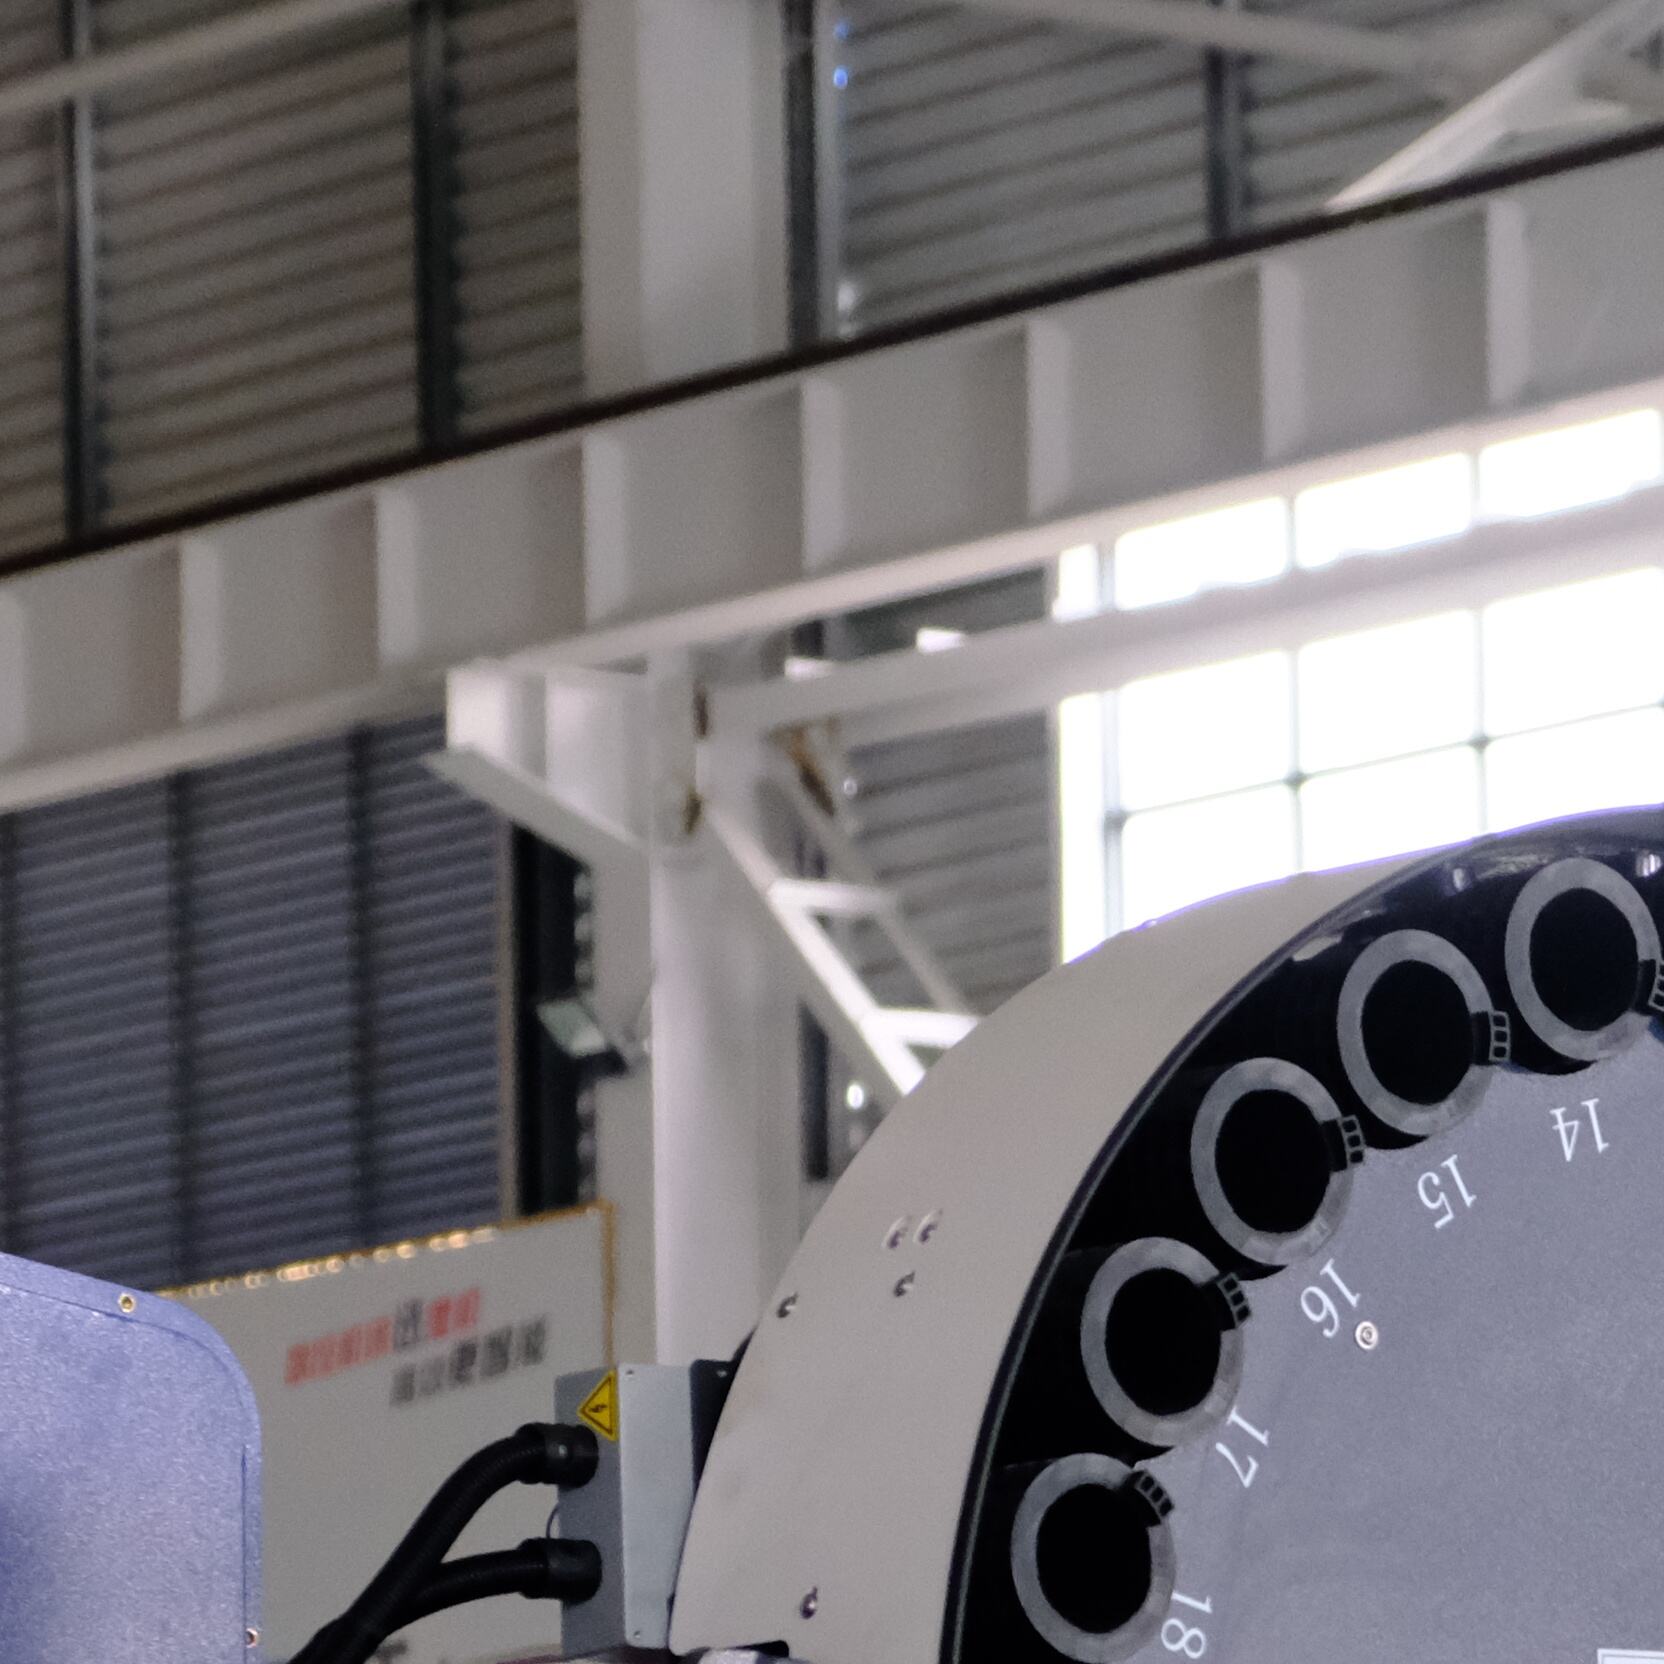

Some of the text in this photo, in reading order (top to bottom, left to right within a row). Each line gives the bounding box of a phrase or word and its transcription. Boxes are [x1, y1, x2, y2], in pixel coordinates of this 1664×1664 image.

[1550, 1098, 1609, 1162] 14
[1417, 1154, 1477, 1231] 15
[1300, 1258, 1361, 1339] 16
[1215, 1408, 1271, 1488] 17
[1160, 1591, 1213, 1660] 18
